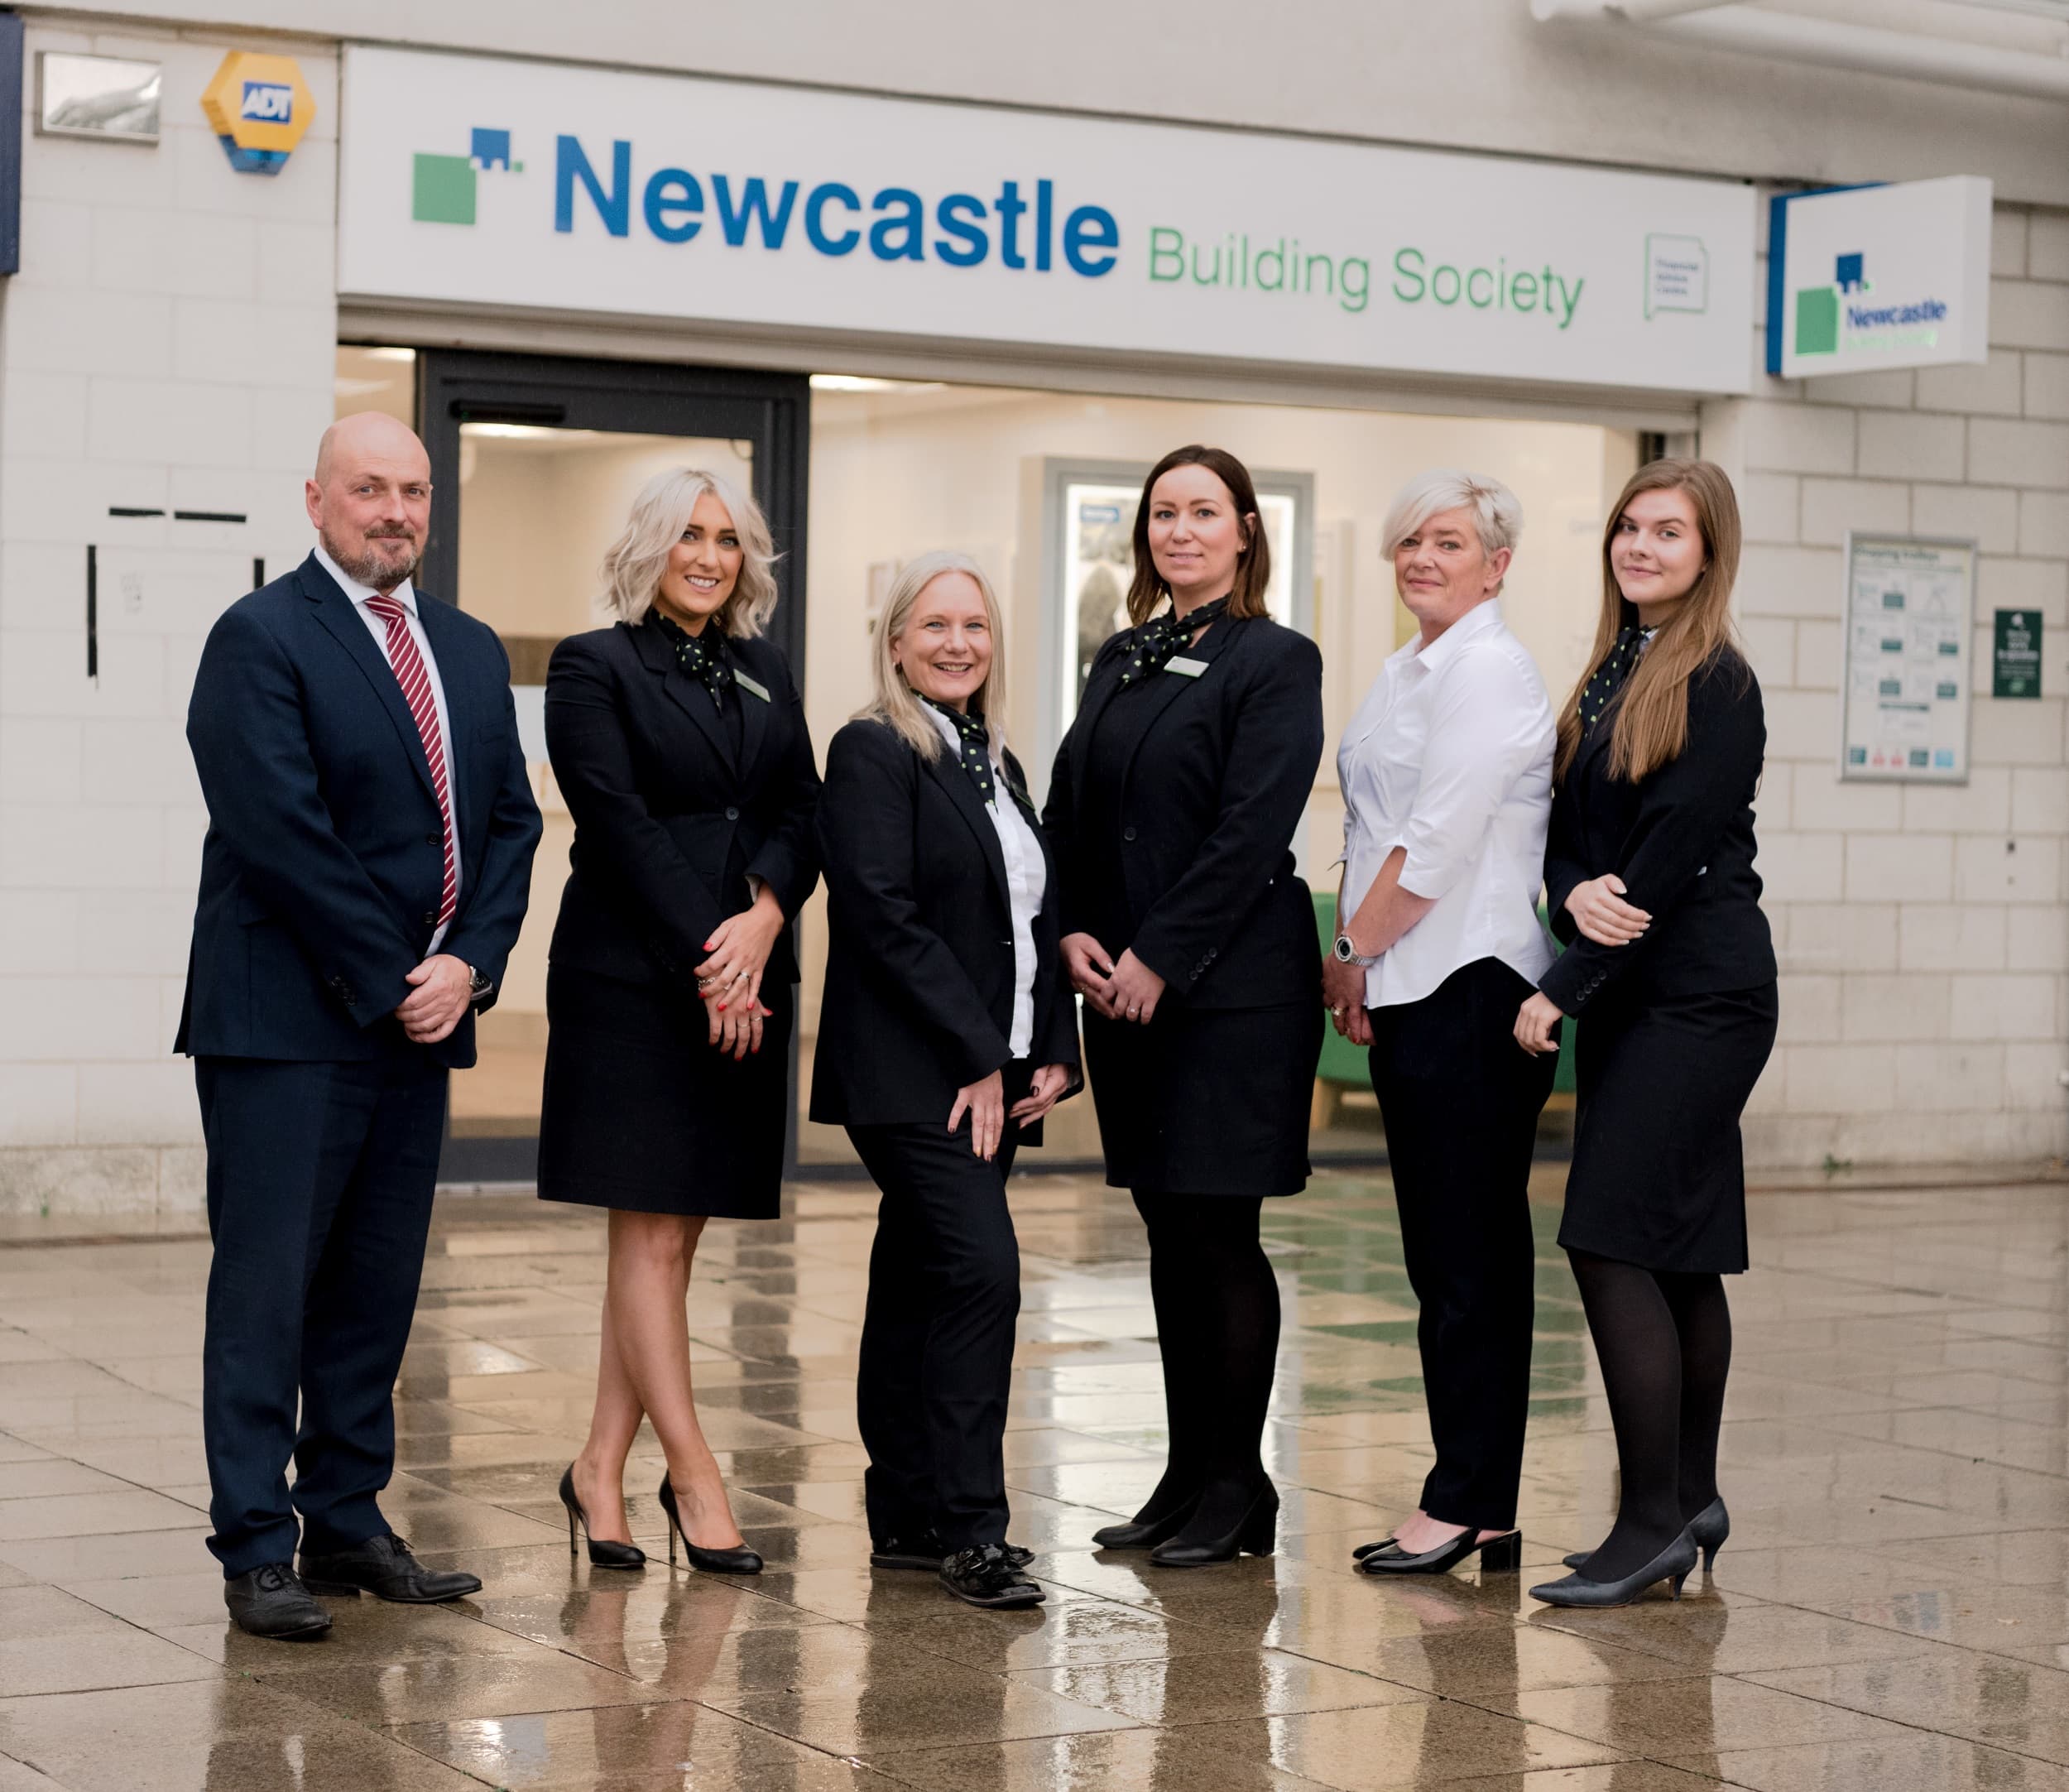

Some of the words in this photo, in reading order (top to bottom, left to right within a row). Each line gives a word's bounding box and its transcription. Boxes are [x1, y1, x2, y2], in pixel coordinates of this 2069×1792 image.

[242, 87, 292, 120] ADT
[555, 135, 1119, 276] Newcastle
[1149, 226, 1370, 312] Building
[1393, 247, 1584, 329] Society
[1847, 298, 1947, 329] Newcastle
